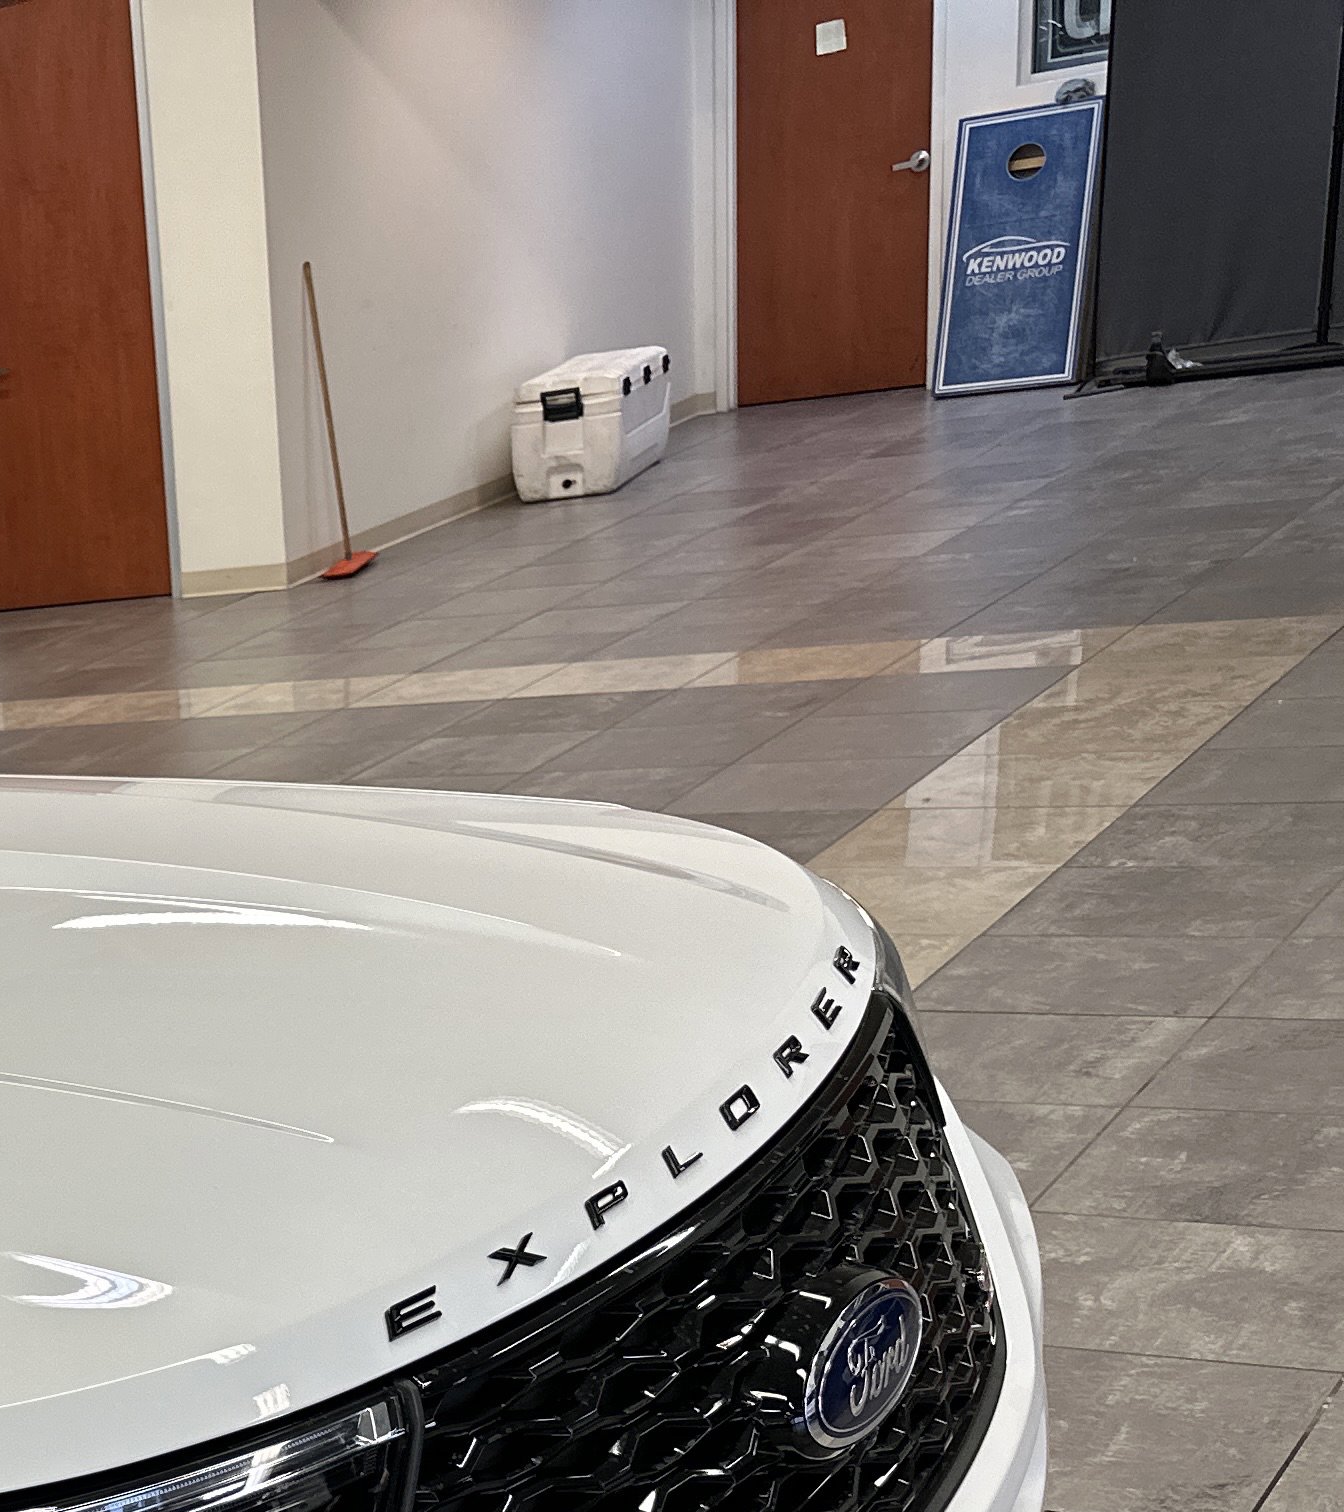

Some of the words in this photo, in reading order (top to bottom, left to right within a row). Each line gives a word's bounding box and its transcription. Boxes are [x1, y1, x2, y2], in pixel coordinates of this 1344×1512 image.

[965, 271, 1014, 287] DEALER
[1017, 265, 1063, 280] GROUP
[966, 247, 1066, 275] KENWOOD
[385, 945, 860, 1342] EXPLORER
[848, 1314, 910, 1417] Ford
